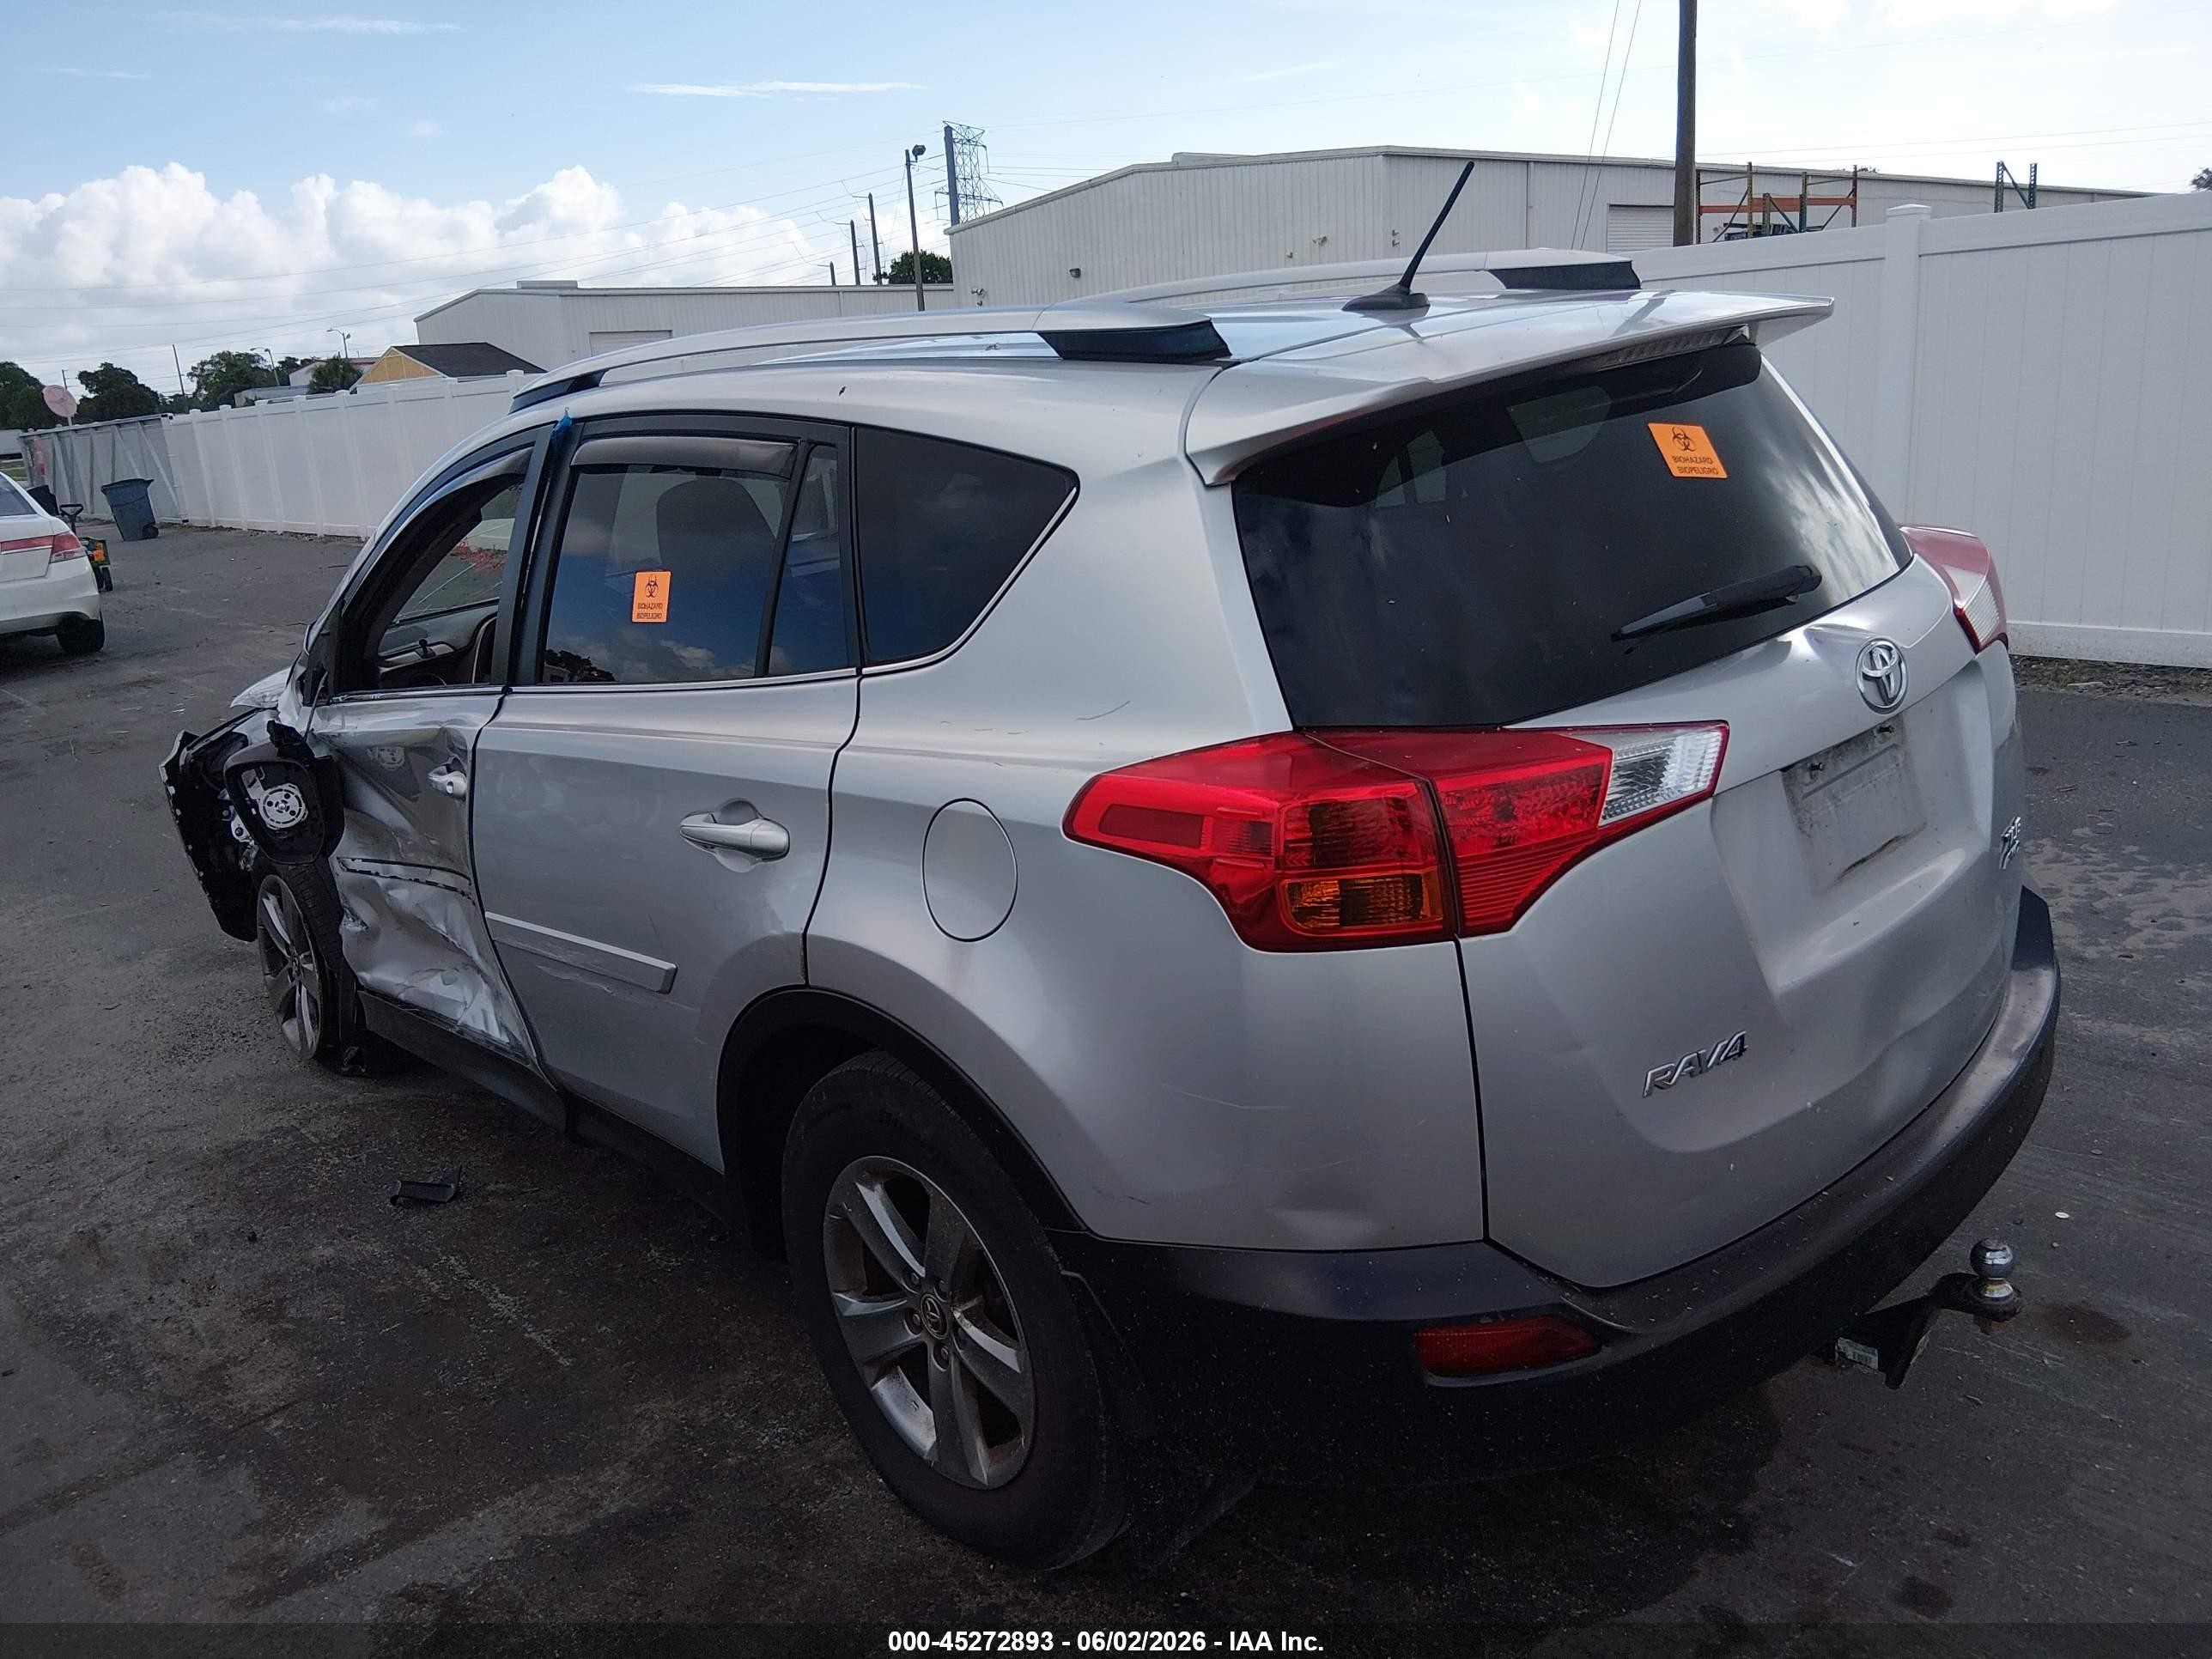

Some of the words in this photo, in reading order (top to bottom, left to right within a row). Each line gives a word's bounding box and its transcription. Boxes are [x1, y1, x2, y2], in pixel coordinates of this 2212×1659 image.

[1672, 456, 1713, 465] BIOHAZARD
[1677, 466, 1718, 475] BIOPELIGRO
[1643, 1030, 1748, 1097] RAV4
